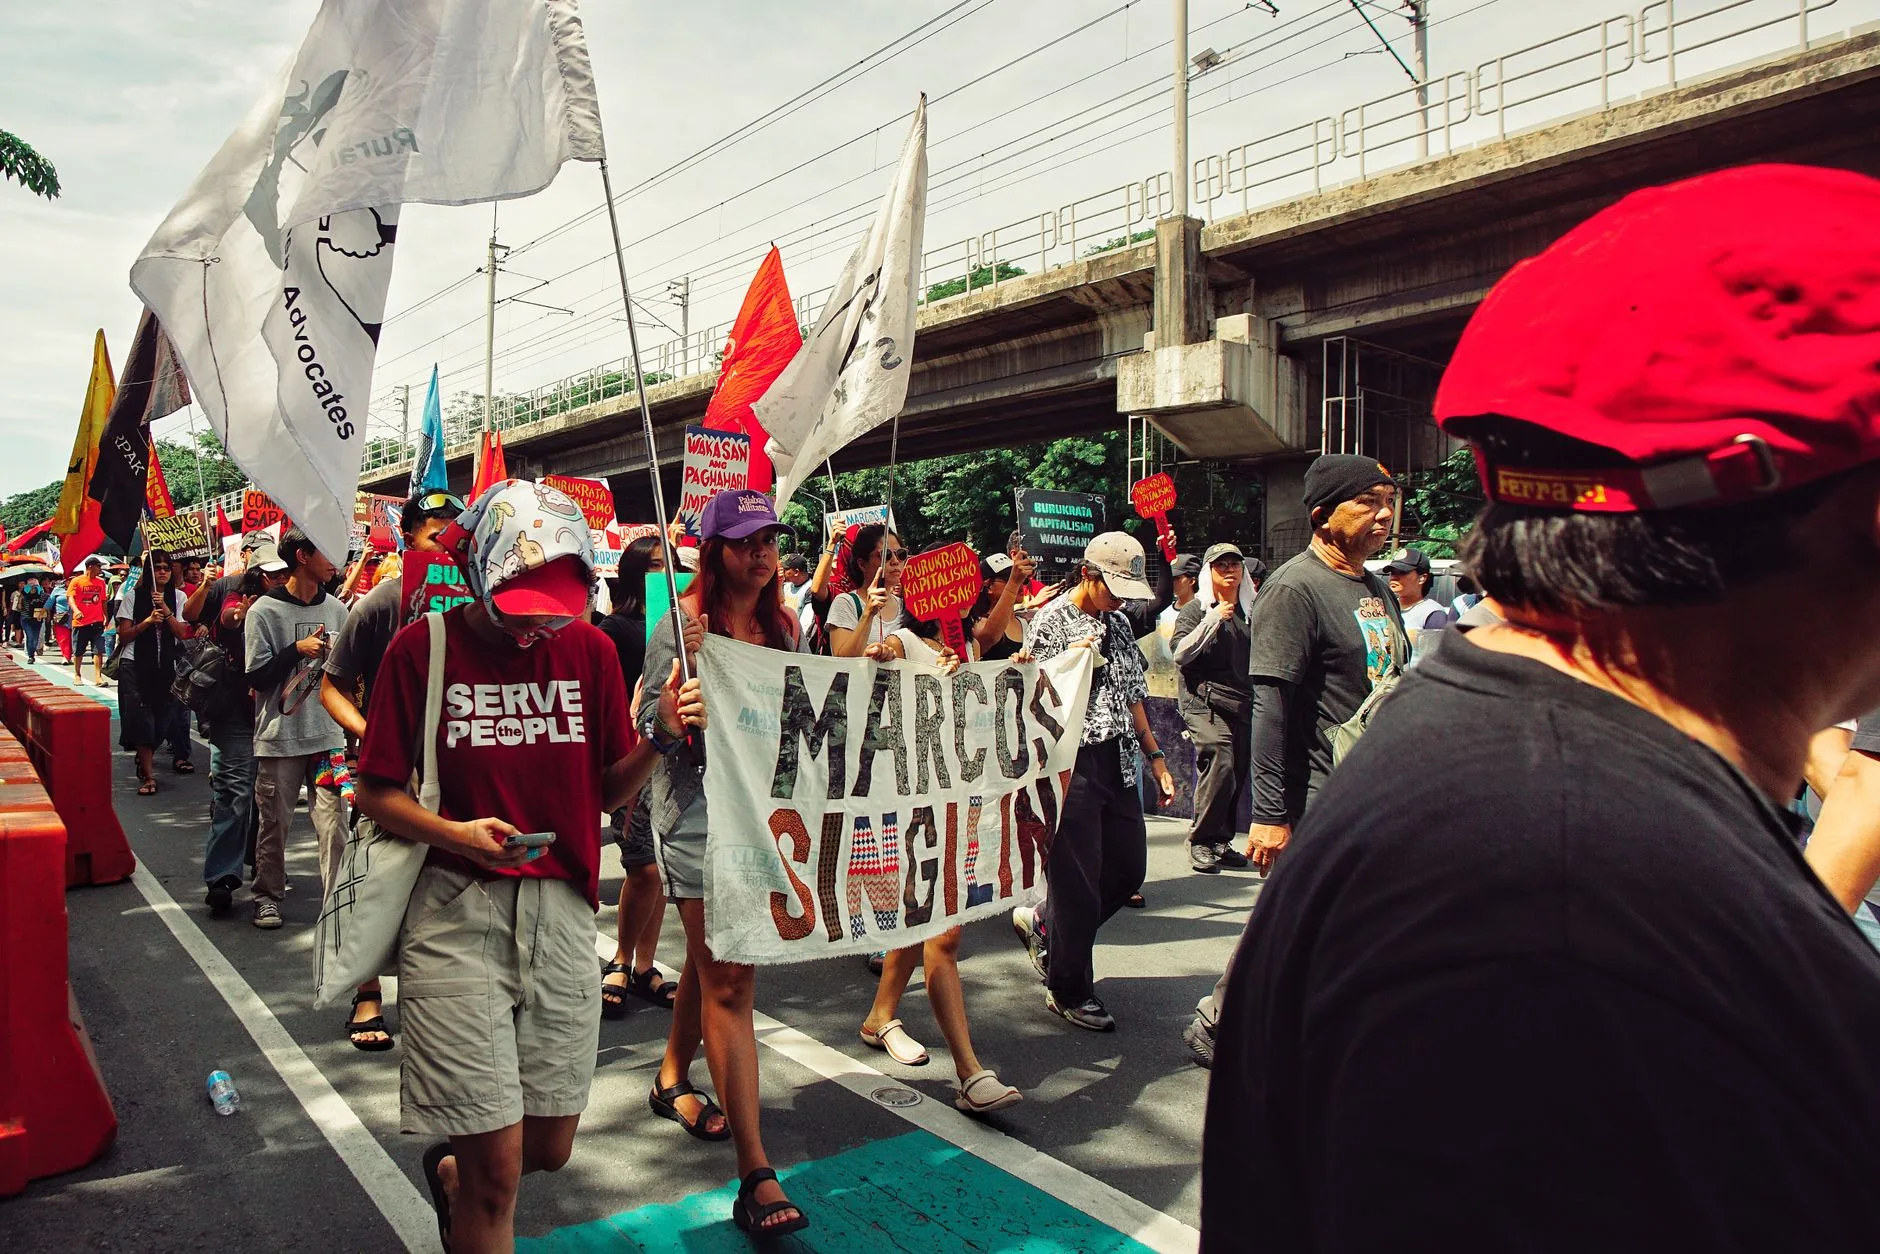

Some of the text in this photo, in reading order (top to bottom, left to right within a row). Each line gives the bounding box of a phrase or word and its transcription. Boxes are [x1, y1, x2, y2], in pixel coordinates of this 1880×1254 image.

[283, 286, 355, 441] Advocates
[687, 436, 748, 464] WAKASAN
[708, 460, 728, 470] ANG
[545, 475, 607, 501] BURUKRATA
[684, 466, 747, 491] PAGHAHARI
[1029, 516, 1095, 534] KAPITALISMO
[1033, 501, 1093, 518] BURUKRATA
[905, 545, 969, 580] BURUKRATA
[903, 560, 977, 599] KAPITALISMO
[913, 580, 977, 617] IBAGSAK!
[446, 680, 583, 718] SERVE
[446, 716, 586, 749] PEOPLE
[497, 725, 522, 737] the
[770, 665, 1065, 800] MARCOS
[768, 768, 1072, 942] SINGILIN
